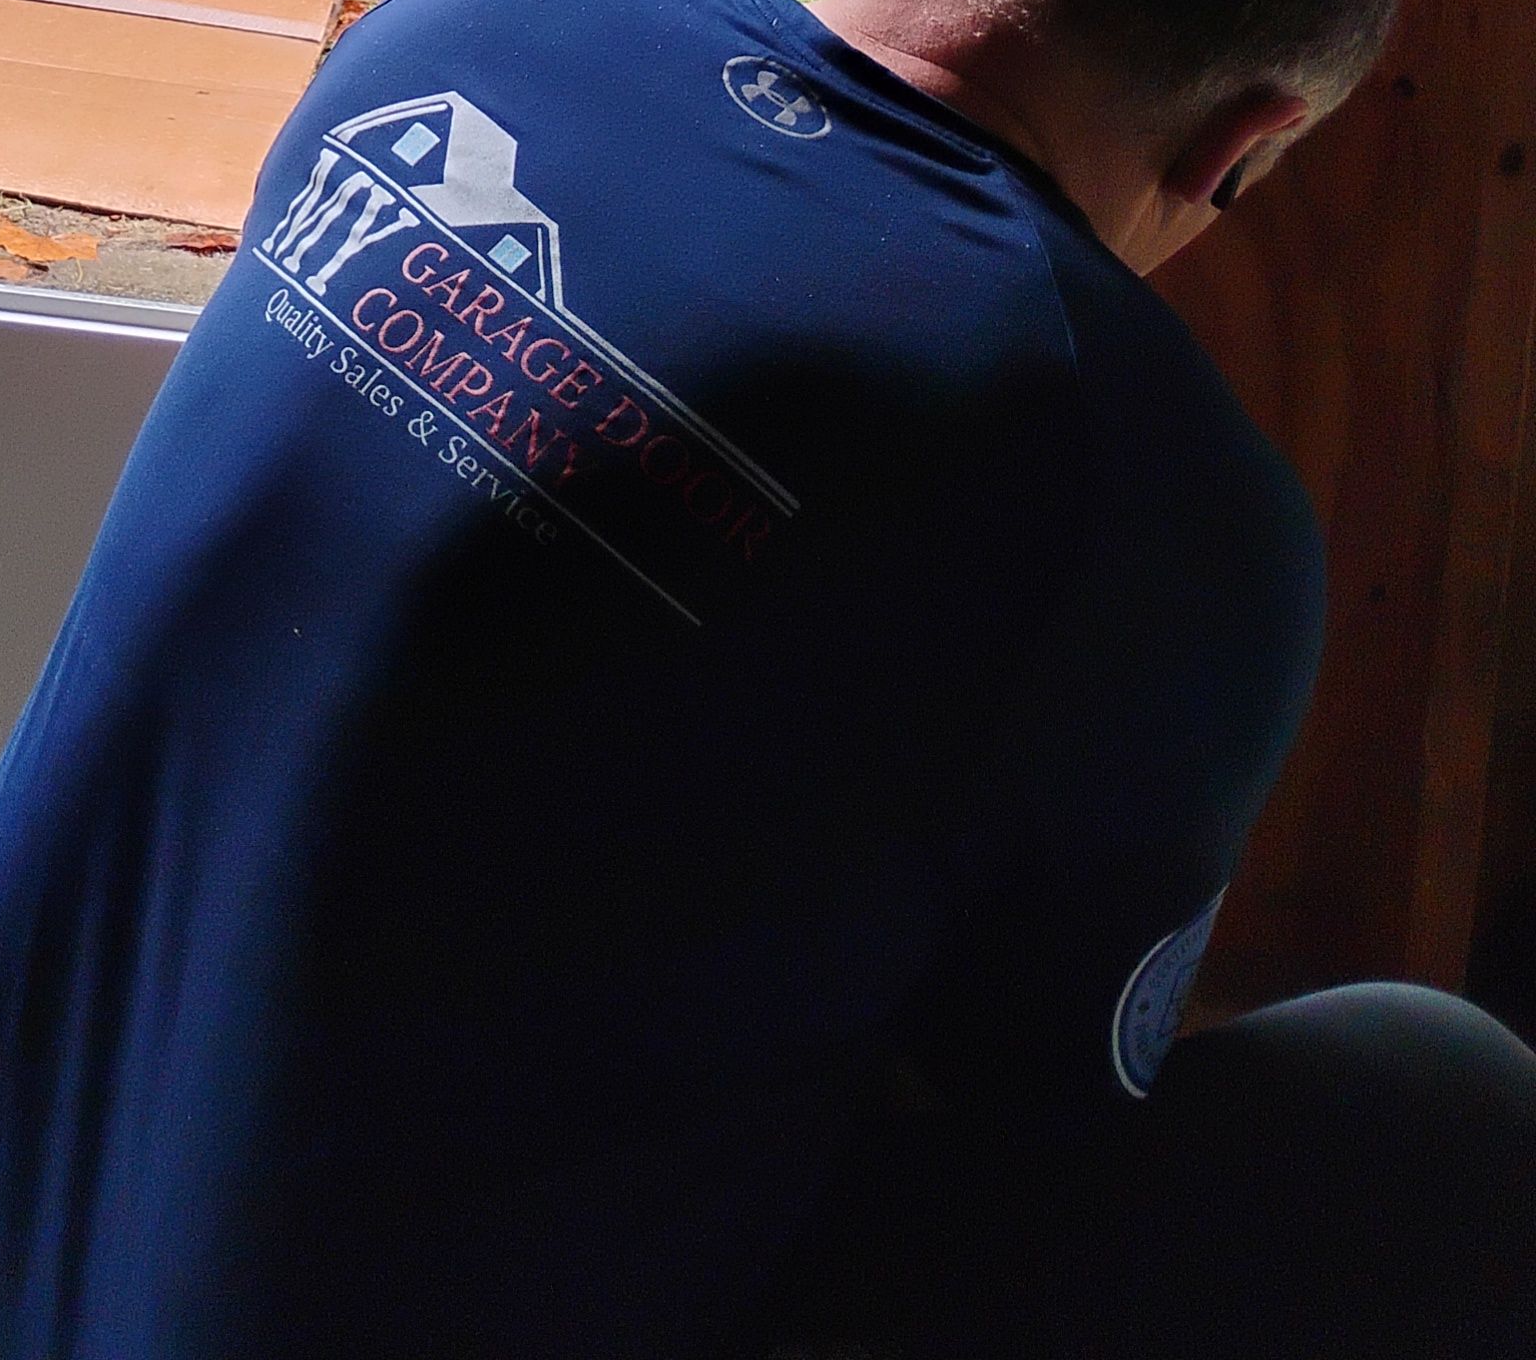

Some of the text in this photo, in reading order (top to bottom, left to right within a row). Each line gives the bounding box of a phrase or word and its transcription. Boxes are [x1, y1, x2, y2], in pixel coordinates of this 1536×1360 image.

[263, 148, 421, 297] MY
[263, 289, 559, 546] Quality Sales & Service
[349, 287, 600, 489] COMPANY
[401, 242, 771, 561] GARAGE DOOR
